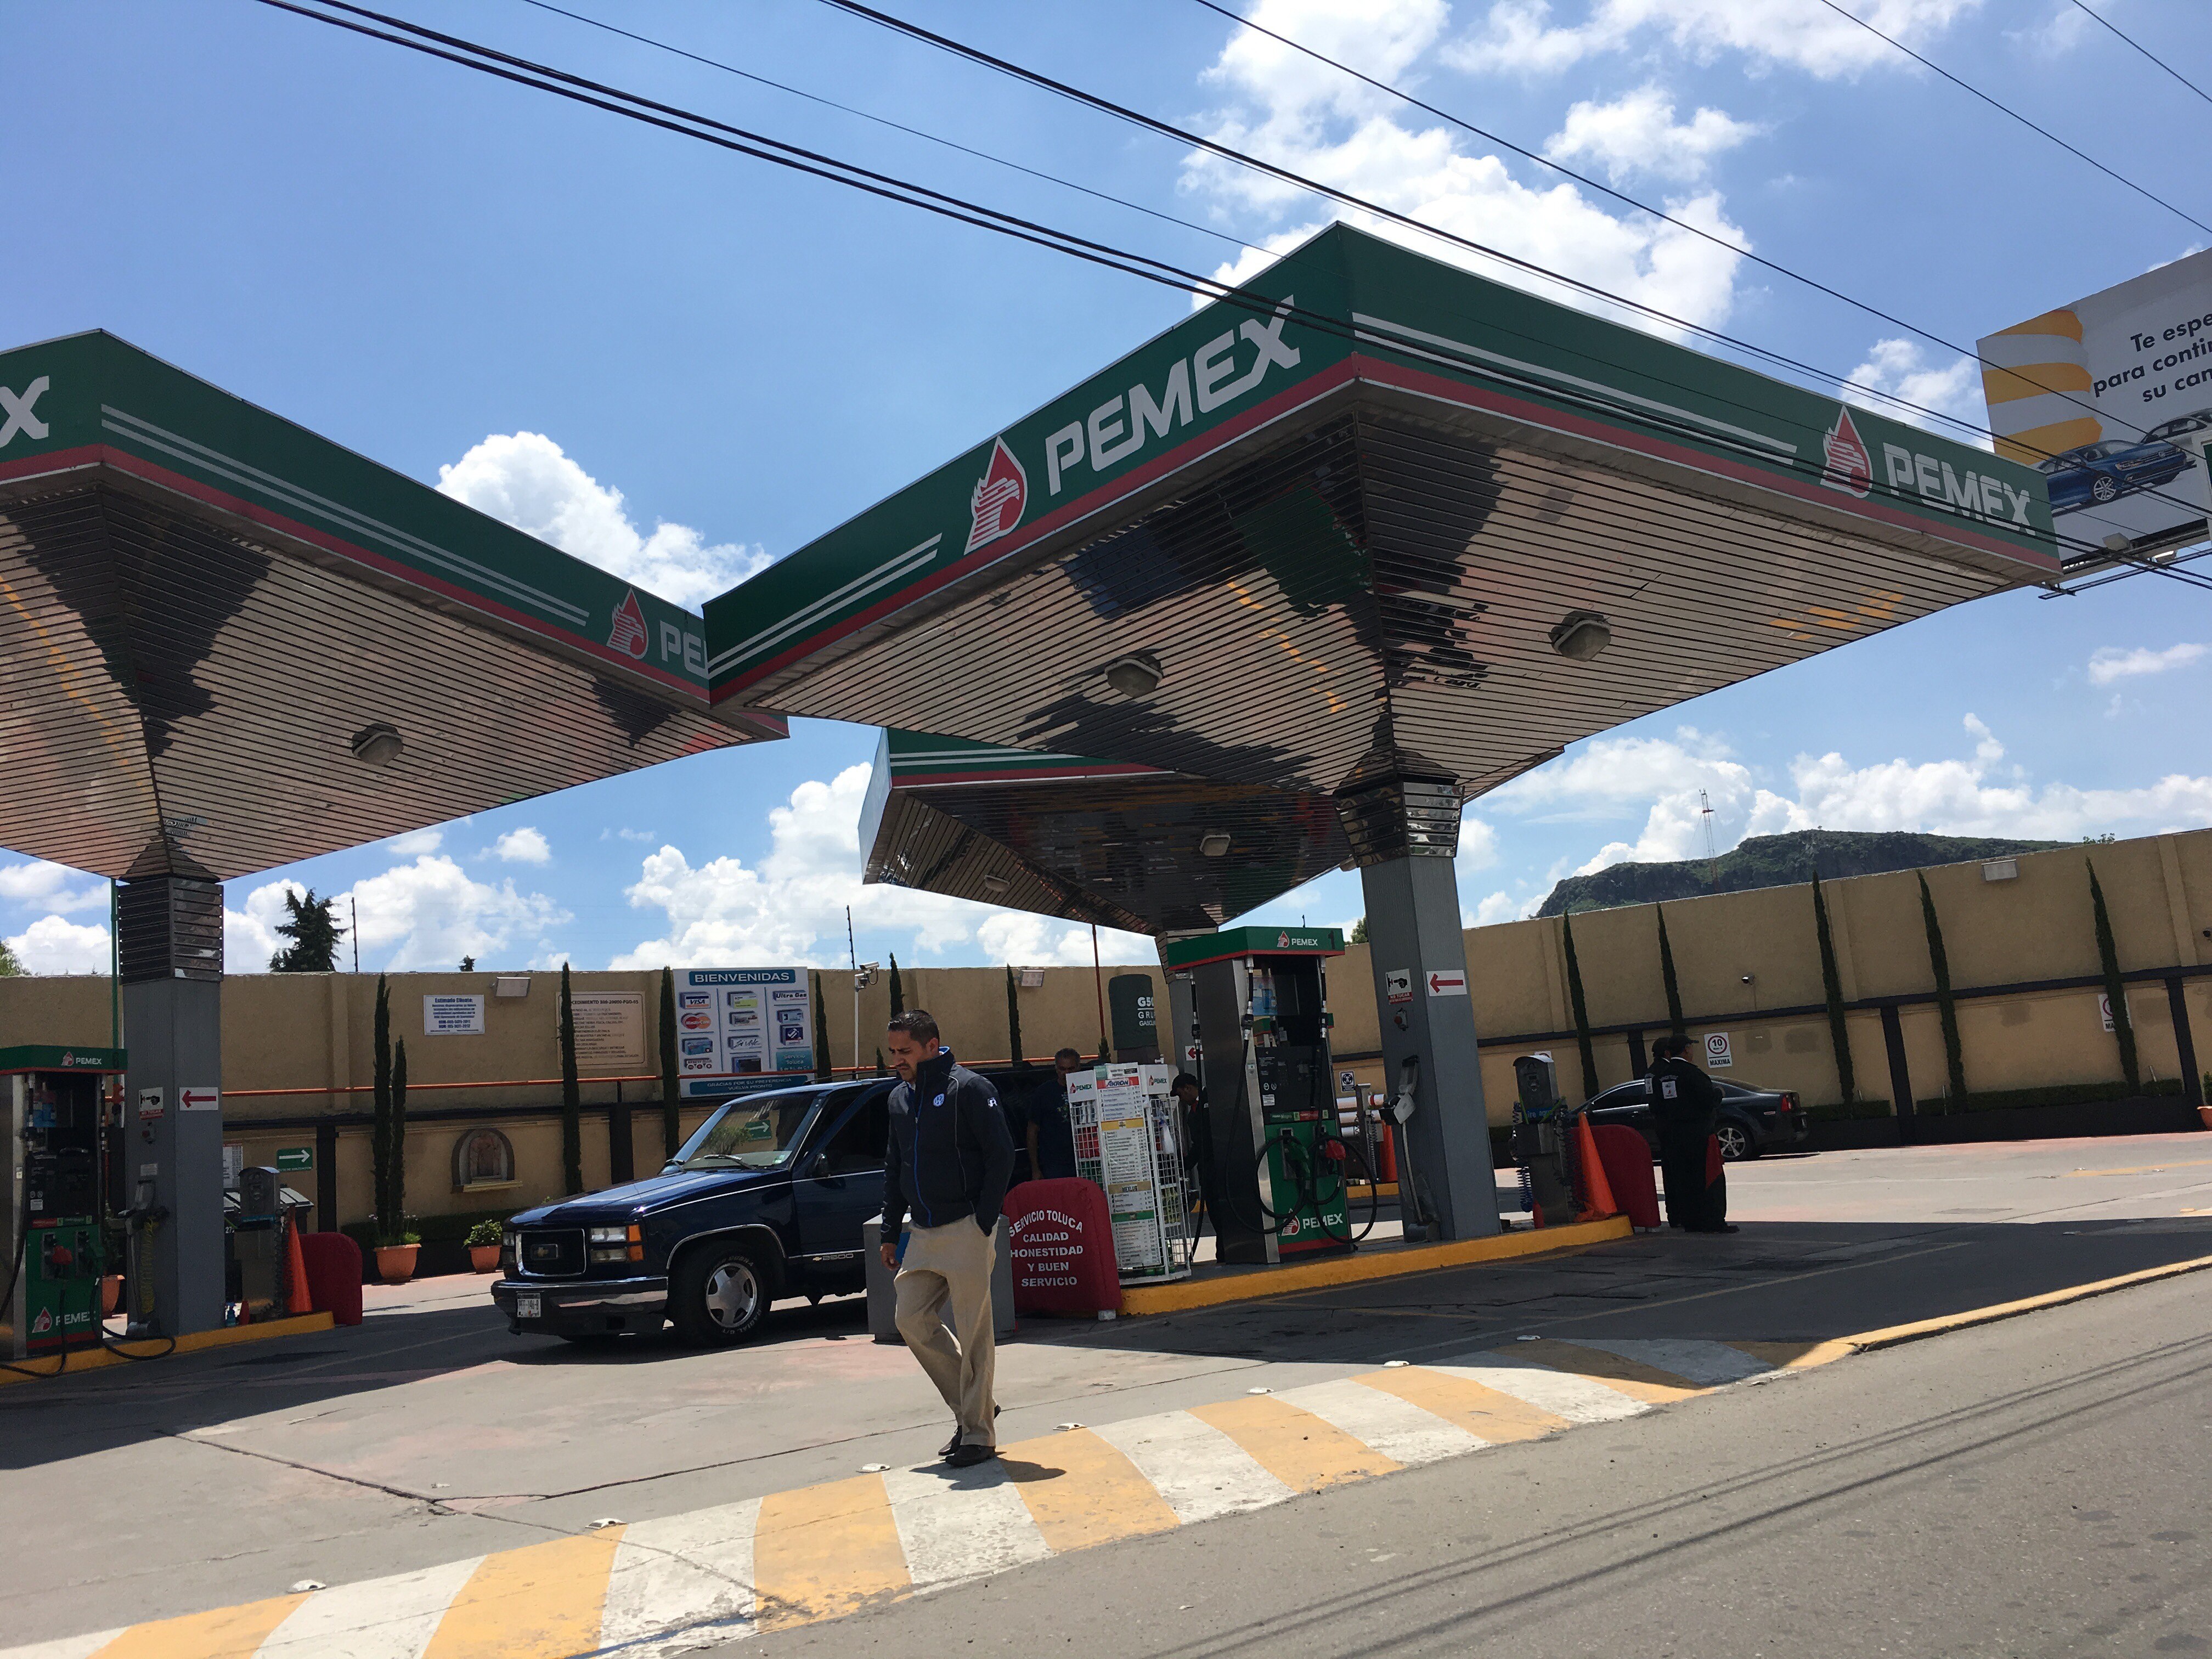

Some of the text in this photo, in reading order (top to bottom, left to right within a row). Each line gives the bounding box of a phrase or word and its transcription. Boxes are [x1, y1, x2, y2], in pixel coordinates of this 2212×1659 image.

[2130, 332, 2155, 352] Te
[2094, 365, 2145, 398] para
[1045, 295, 1301, 496] PEMEX
[2142, 385, 2166, 402] su
[1883, 442, 2036, 536] PEMEX
[660, 620, 709, 680] PE
[1291, 938, 1318, 946] PEMEX
[695, 972, 790, 983] BIENVENIDAS
[1712, 1039, 1723, 1047] 10
[1009, 1210, 1082, 1237] SERVICIO TOLUCA
[1023, 1232, 1069, 1243] CALIDAD
[1011, 1245, 1084, 1258] HONESTIDAD
[1027, 1262, 1069, 1272] Y BUEN
[1021, 1277, 1077, 1287] SERVICIO
[55, 1311, 97, 1326] PEME
